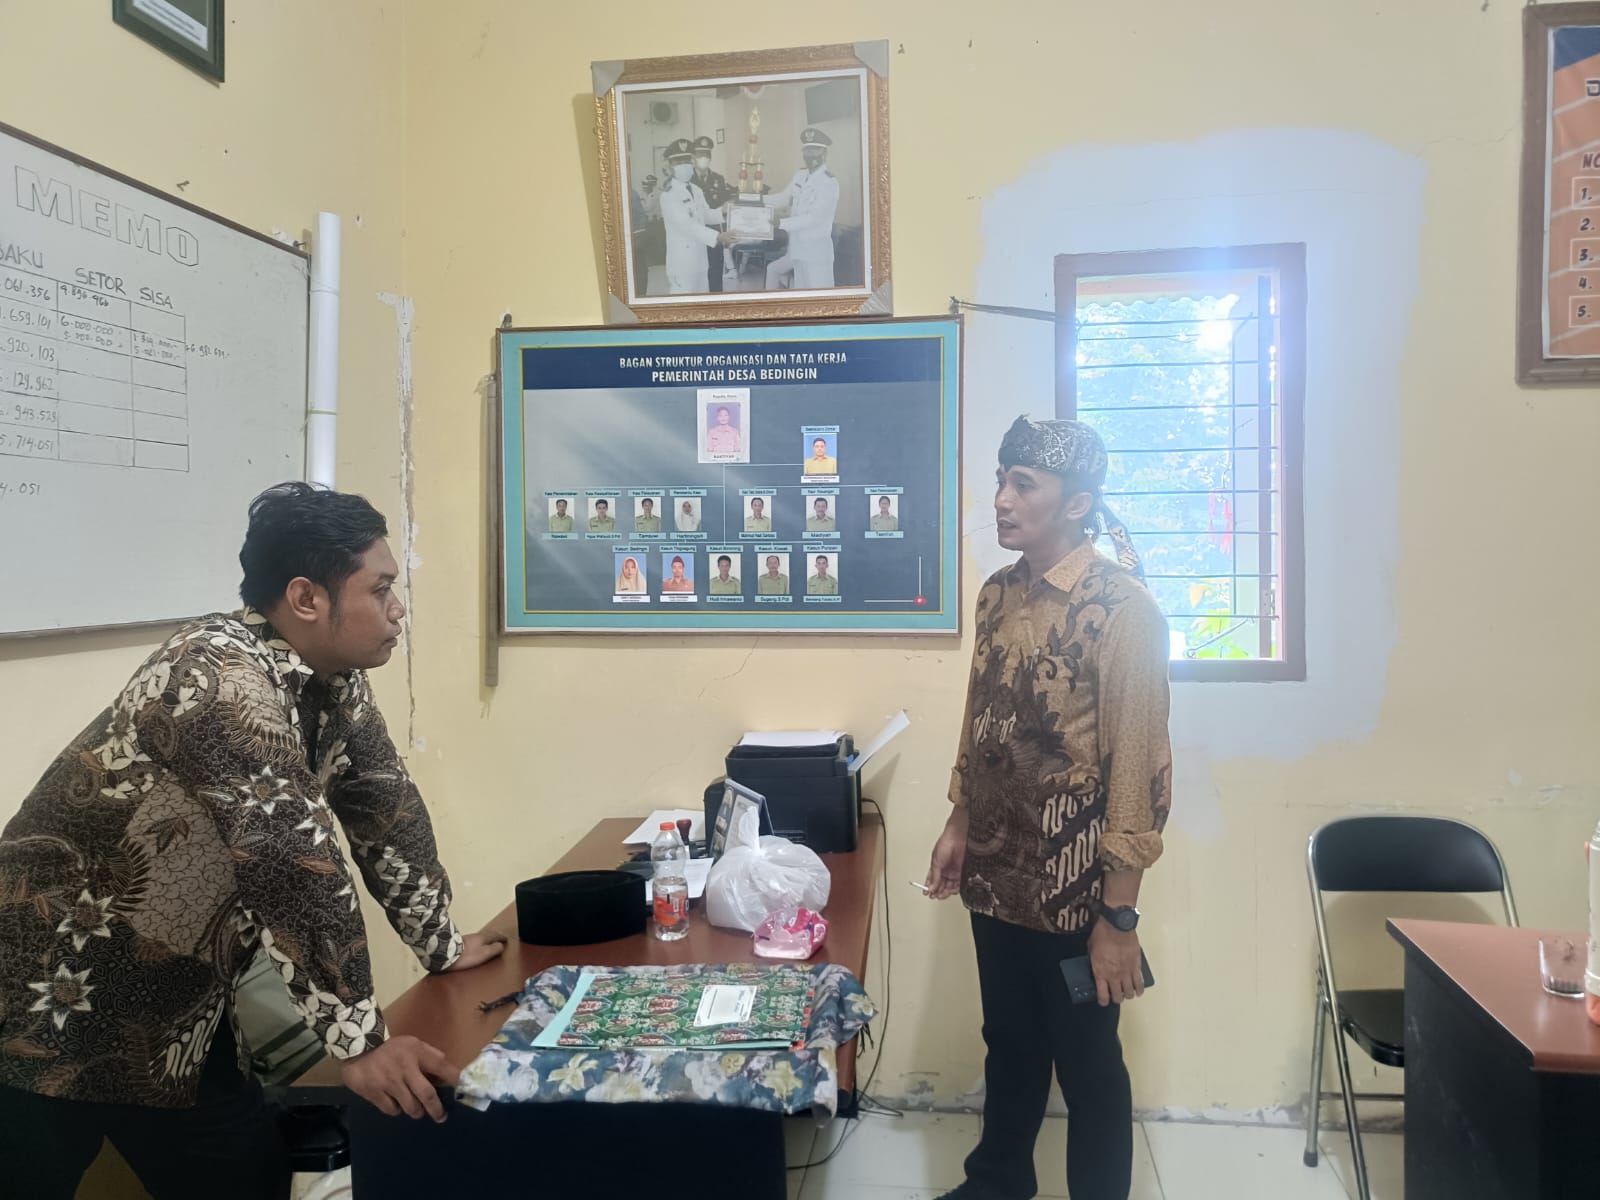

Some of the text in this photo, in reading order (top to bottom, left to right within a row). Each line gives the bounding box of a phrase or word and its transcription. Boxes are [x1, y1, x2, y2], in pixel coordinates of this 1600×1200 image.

[1581, 187, 1593, 201] 1.
[14, 165, 199, 268] MEMO
[1580, 217, 1596, 232] 2.
[1579, 248, 1594, 262] 3.
[75, 267, 127, 296] SETOR
[140, 286, 174, 310] SISA
[1577, 305, 1592, 318] 5.
[619, 352, 847, 369] BAGAN STRUKTUR ORGANISASI DAN TATA KERJA
[651, 367, 818, 383] PEMERINTAH DESA BEDINGIN
